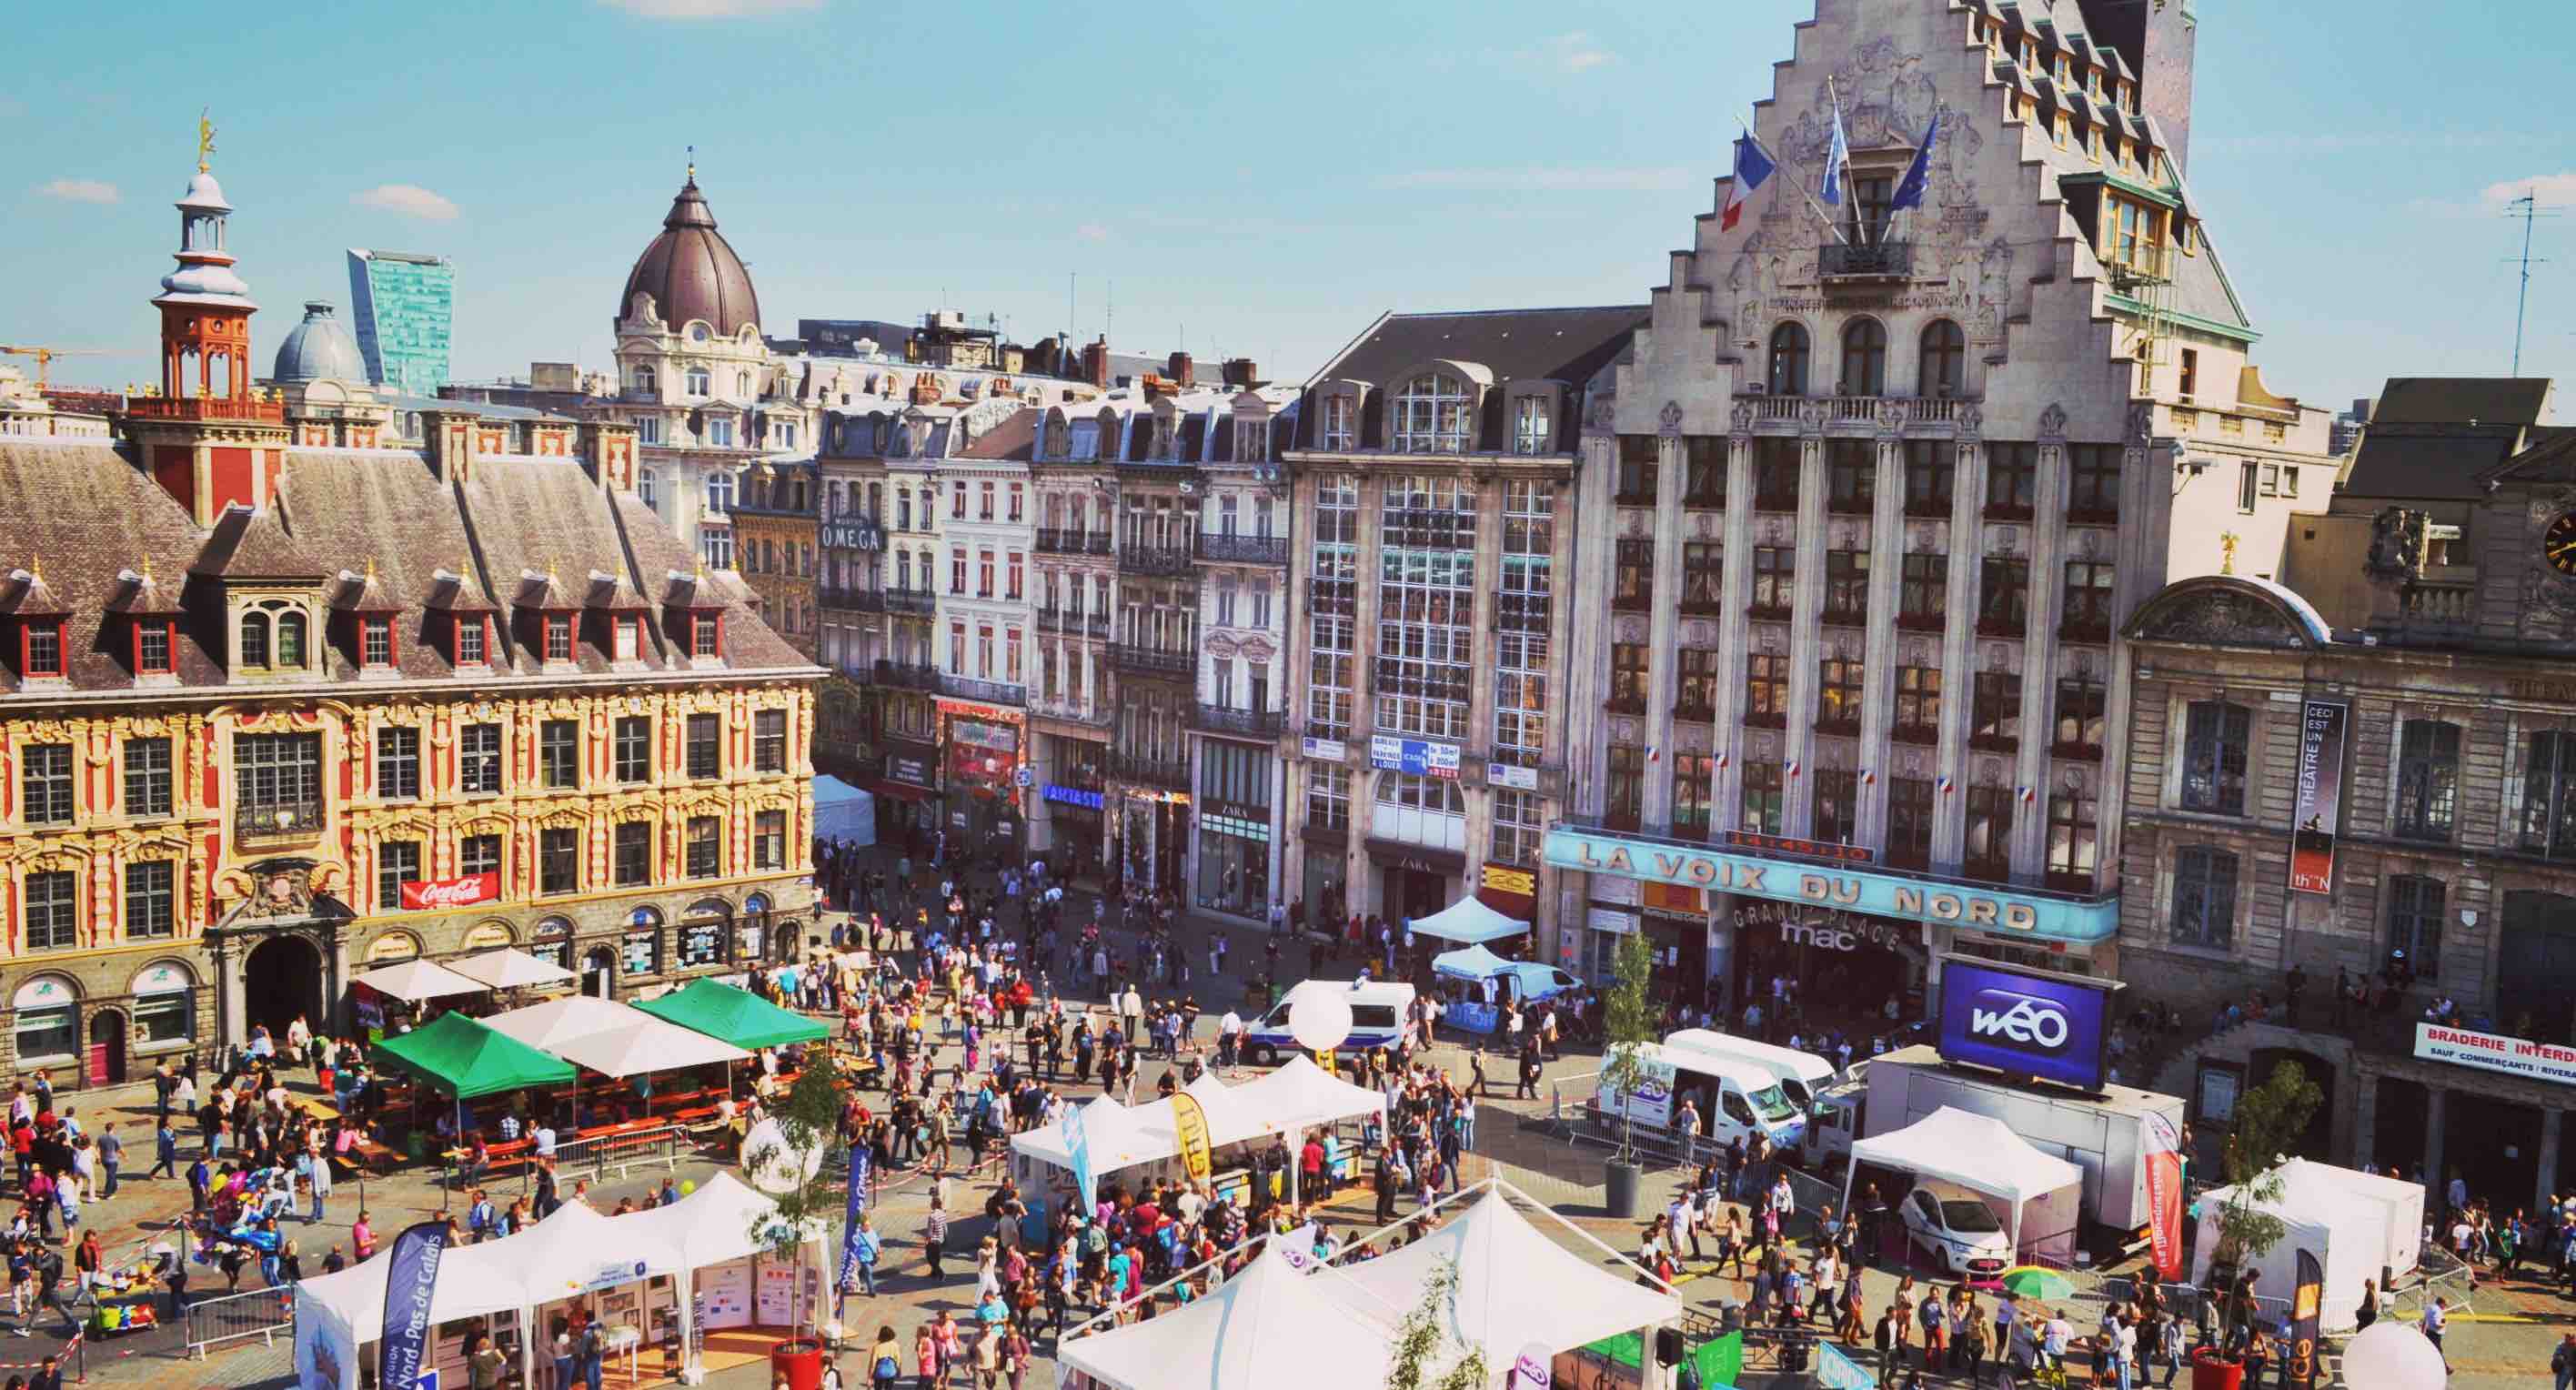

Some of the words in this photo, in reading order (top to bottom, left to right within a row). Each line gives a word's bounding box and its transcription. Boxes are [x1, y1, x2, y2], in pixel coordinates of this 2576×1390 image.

[822, 526, 880, 550] OMEGA
[2308, 706, 2334, 719] CECI
[2306, 731, 2323, 742] UN
[2308, 720, 2329, 730] EST
[1222, 804, 1249, 818] ZARA
[1401, 857, 1432, 872] ZARA
[1578, 842, 1635, 871] LA
[1653, 851, 1767, 892] VOIX
[1800, 873, 1862, 905] DU
[1894, 887, 2038, 932] NORD
[1827, 911, 1901, 952] PLACE
[2428, 1028, 2507, 1053] BRADERIE
[2430, 1047, 2455, 1058] SAUF
[2459, 1053, 2534, 1072] COMMERÇANTS
[418, 1234, 442, 1283] Calais
[415, 1284, 431, 1308] de
[405, 1309, 426, 1340] Pas
[397, 1347, 420, 1389] Nord
